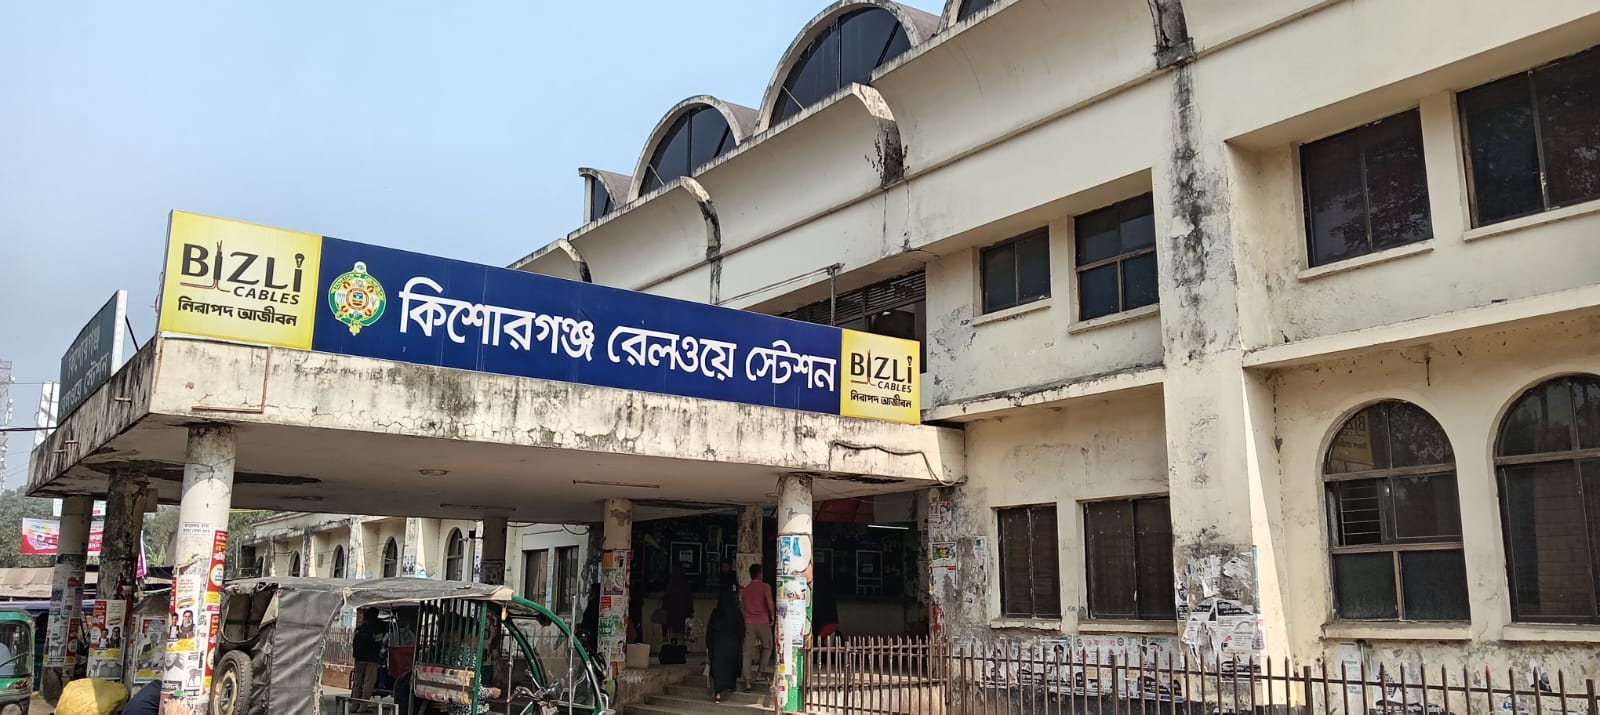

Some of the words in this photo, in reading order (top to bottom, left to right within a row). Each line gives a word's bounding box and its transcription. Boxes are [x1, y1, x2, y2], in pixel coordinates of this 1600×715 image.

[233, 286, 300, 305] CABLES
[178, 296, 234, 317] নিরাপদ
[237, 305, 297, 326] আজীবন
[398, 276, 595, 361] কিশোরগঞ্জ
[607, 326, 737, 381] রেলওয়ে
[745, 339, 837, 392] স্টেশন
[877, 381, 913, 393] CABLES
[850, 389, 879, 403] নিরাপদ
[880, 394, 912, 408] আজীবন
